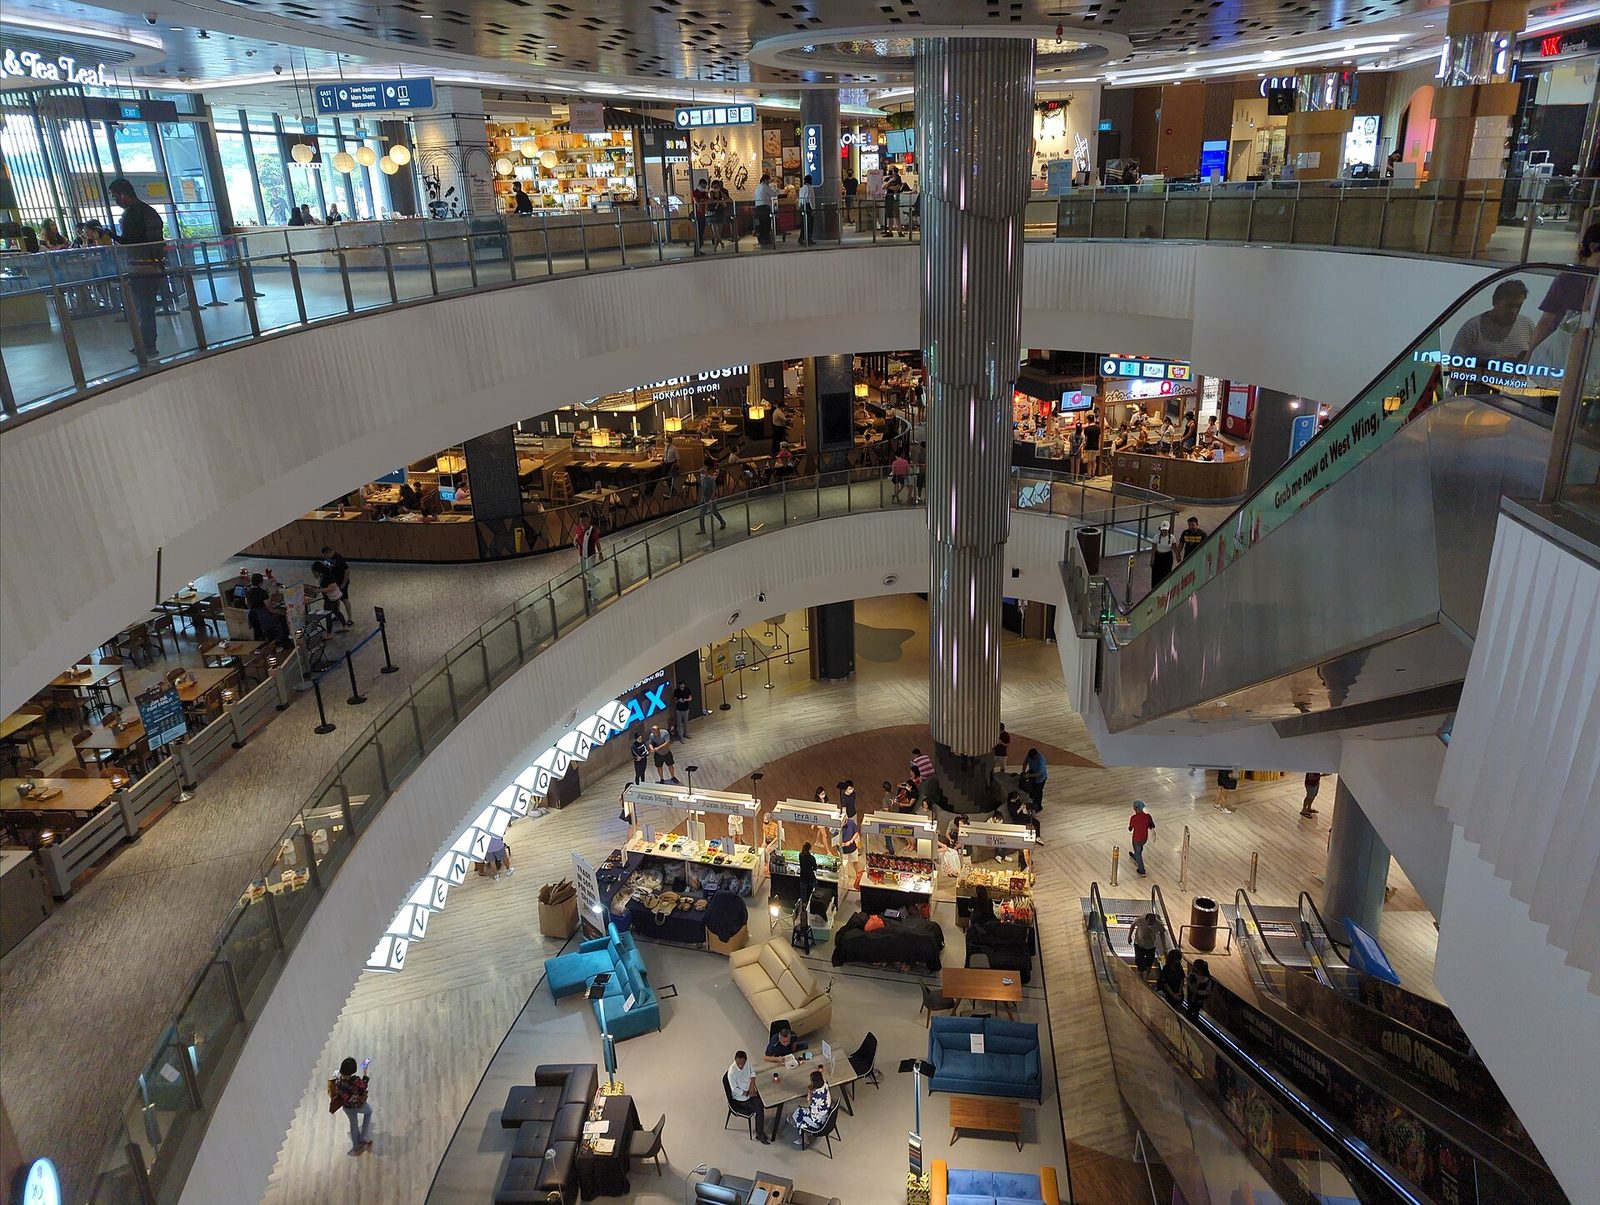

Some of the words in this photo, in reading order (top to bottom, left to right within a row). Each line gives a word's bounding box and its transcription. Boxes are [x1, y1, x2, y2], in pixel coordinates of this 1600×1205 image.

[1541, 35, 1562, 57] NK
[4, 48, 24, 76] &
[21, 51, 60, 81] Tea
[125, 108, 136, 117] EXIT
[652, 387, 695, 401] HOKKAIDO
[697, 383, 720, 394] RYORI
[1274, 484, 1291, 509] Grab
[1292, 479, 1302, 493] me
[1303, 463, 1318, 487] now
[1320, 453, 1329, 471] at
[1329, 434, 1350, 463] West
[1411, 371, 1417, 395] 1
[395, 835, 485, 963] EVENT
[518, 709, 626, 810] SQUARE
